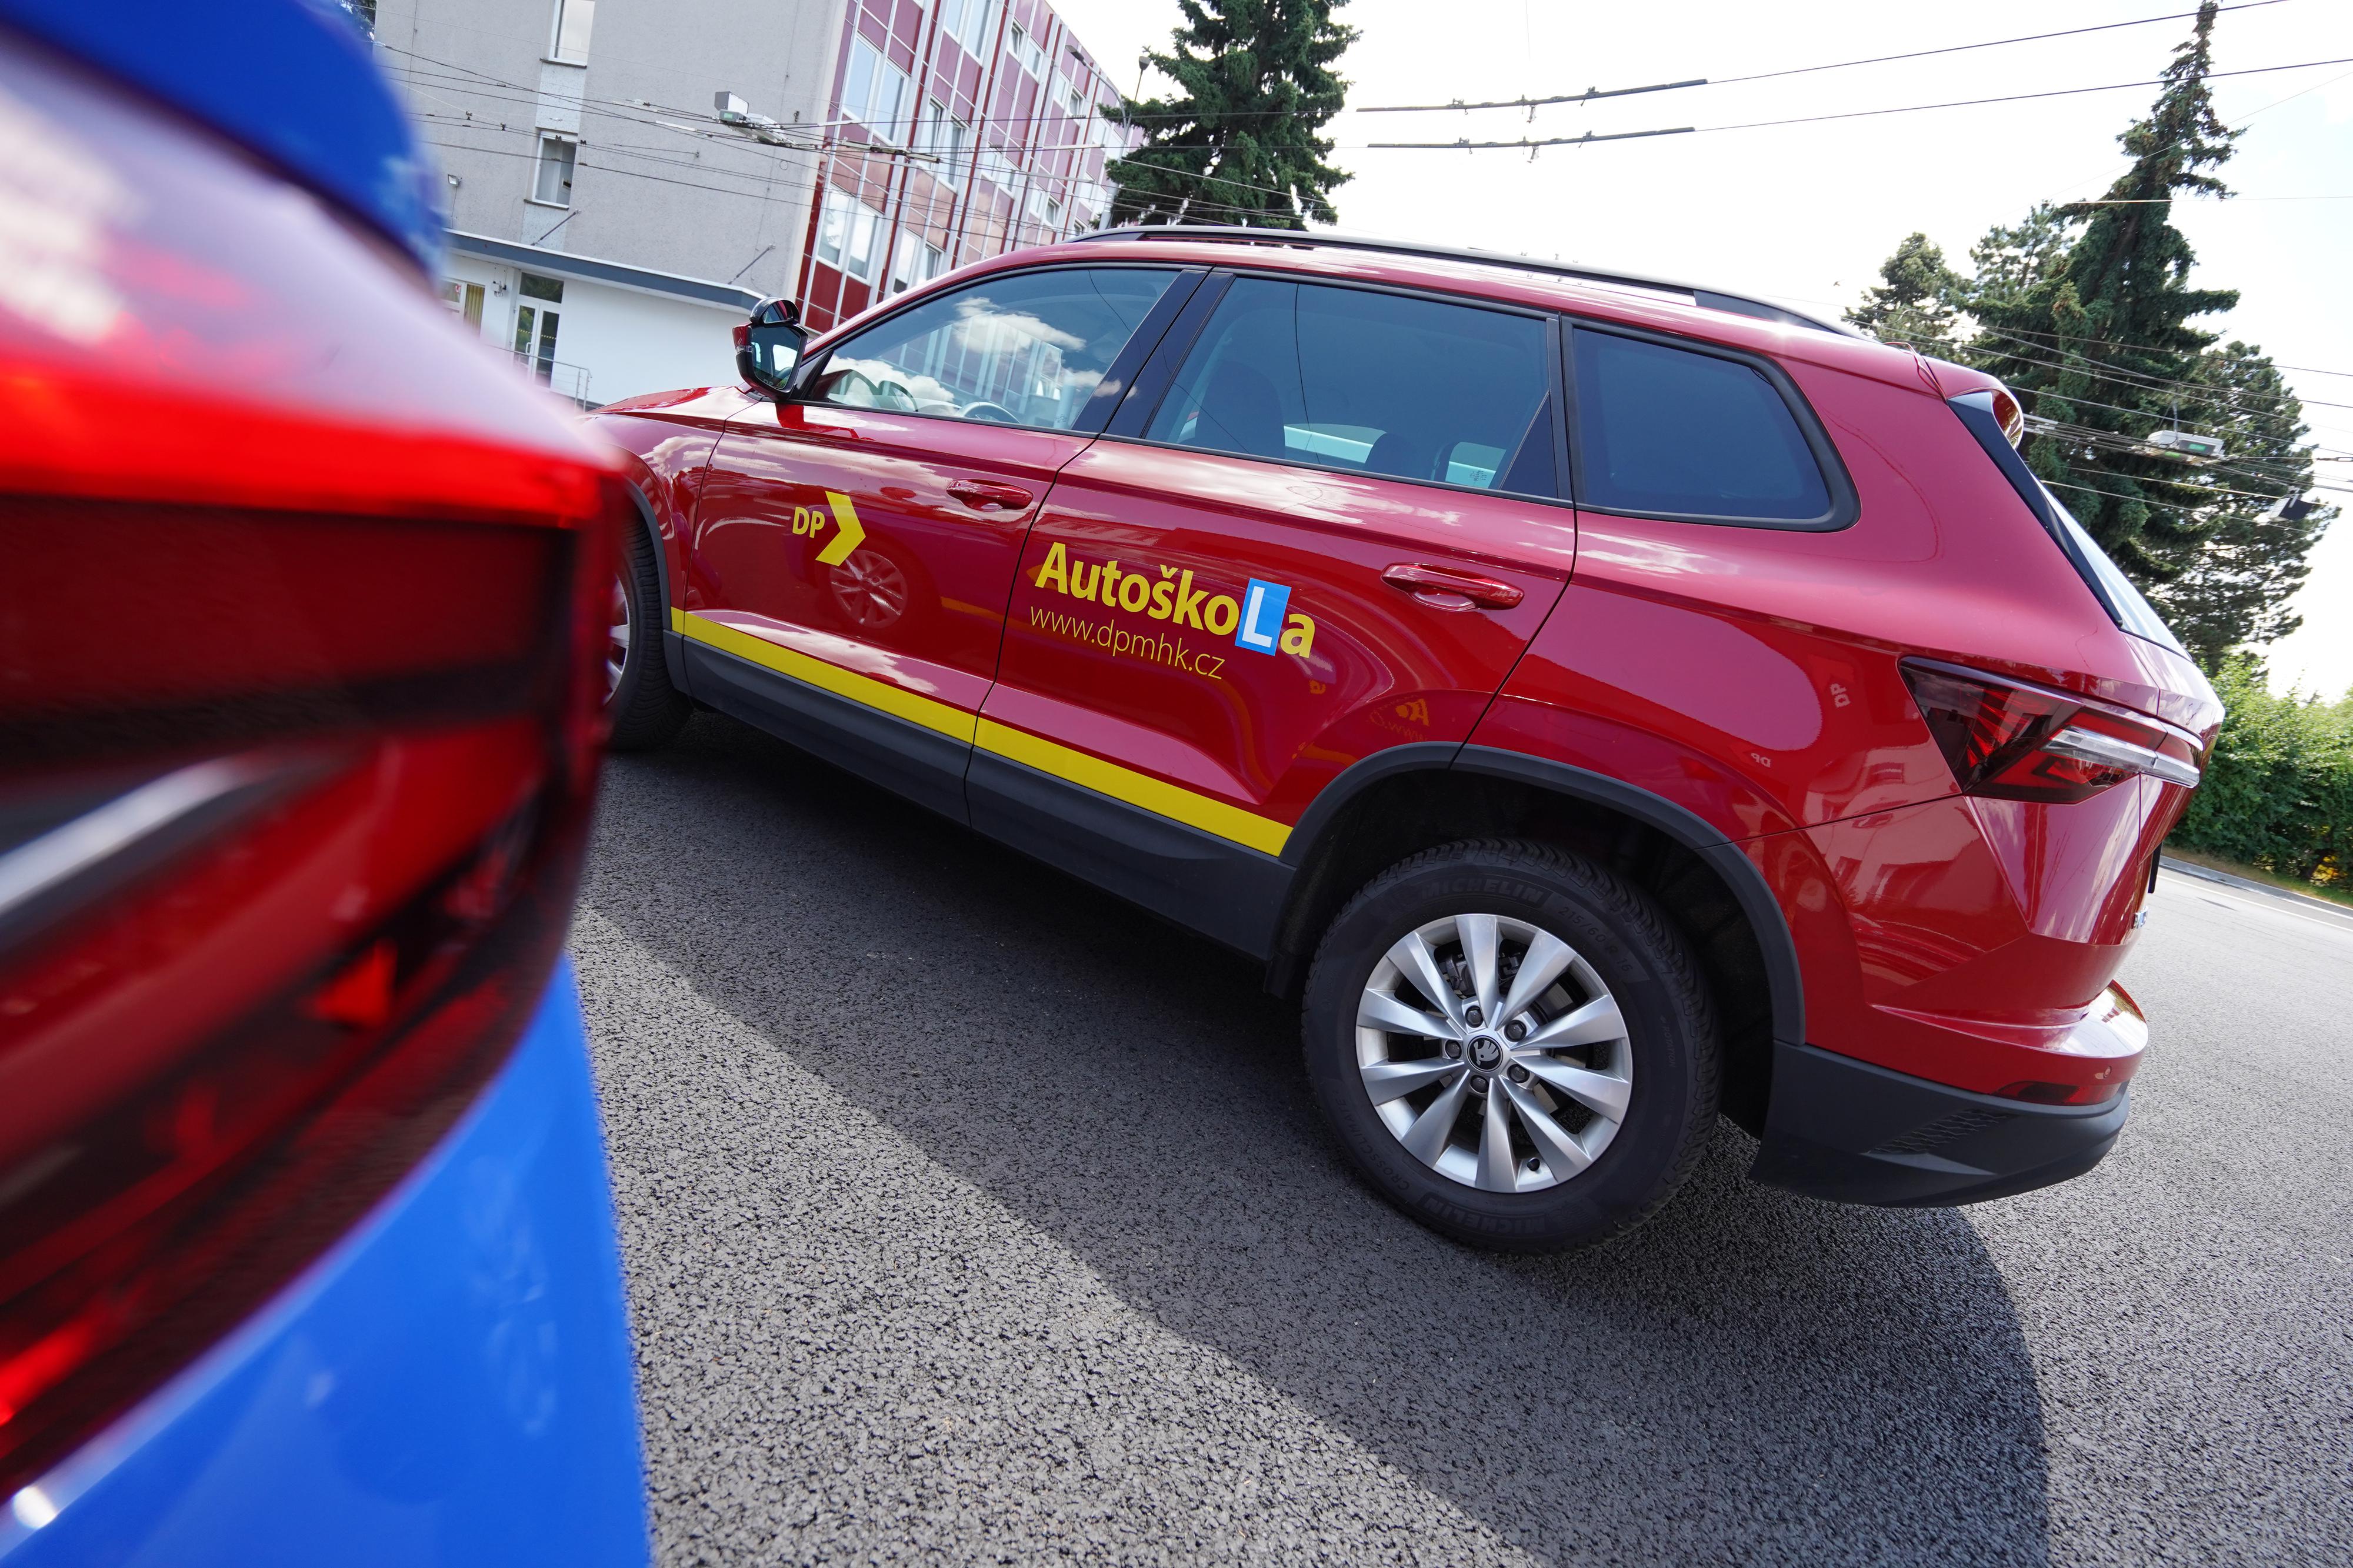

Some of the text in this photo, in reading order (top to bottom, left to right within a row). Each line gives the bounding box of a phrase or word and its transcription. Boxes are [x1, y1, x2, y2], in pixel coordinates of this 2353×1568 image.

[792, 506, 825, 538] DP
[1030, 606, 1226, 680] www.dpmhk.cz
[1420, 878, 1545, 902] MICHELIN
[1559, 906, 1607, 942] 215/60
[1618, 957, 1634, 971] 16
[1424, 1197, 1547, 1233] MICHELIN
